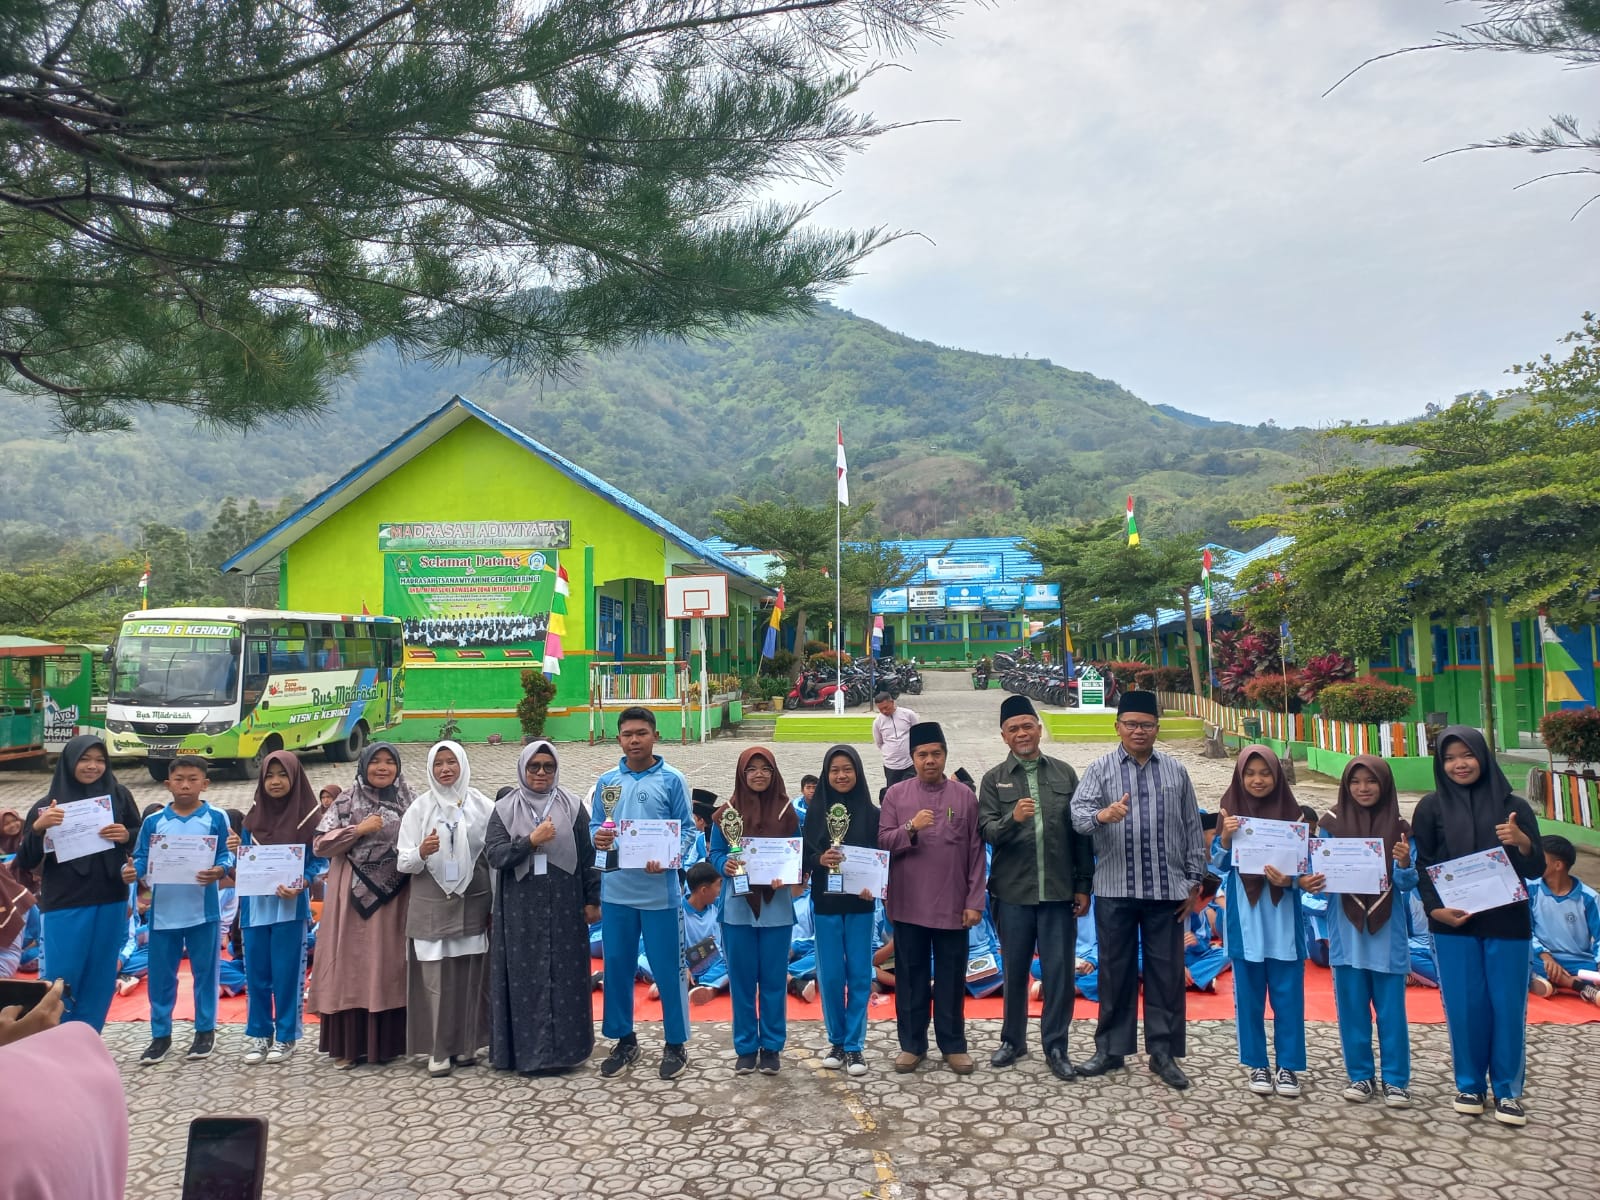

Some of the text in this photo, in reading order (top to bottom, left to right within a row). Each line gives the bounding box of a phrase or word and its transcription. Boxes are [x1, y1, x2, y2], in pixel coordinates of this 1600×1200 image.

[390, 521, 558, 539] MADRASAH ADIWIYATA
[419, 554, 521, 569] Selamat Datang
[438, 576, 480, 584] TSANAWIYAH
[481, 575, 505, 583] NEGERI
[513, 575, 540, 583] KERINCI
[138, 625, 232, 635] MTSN 6 KERINCI
[311, 687, 333, 706] Bus
[54, 704, 76, 722] Ayo!
[136, 711, 151, 720] Bus
[288, 713, 311, 723] MTSN
[313, 711, 320, 721] 6
